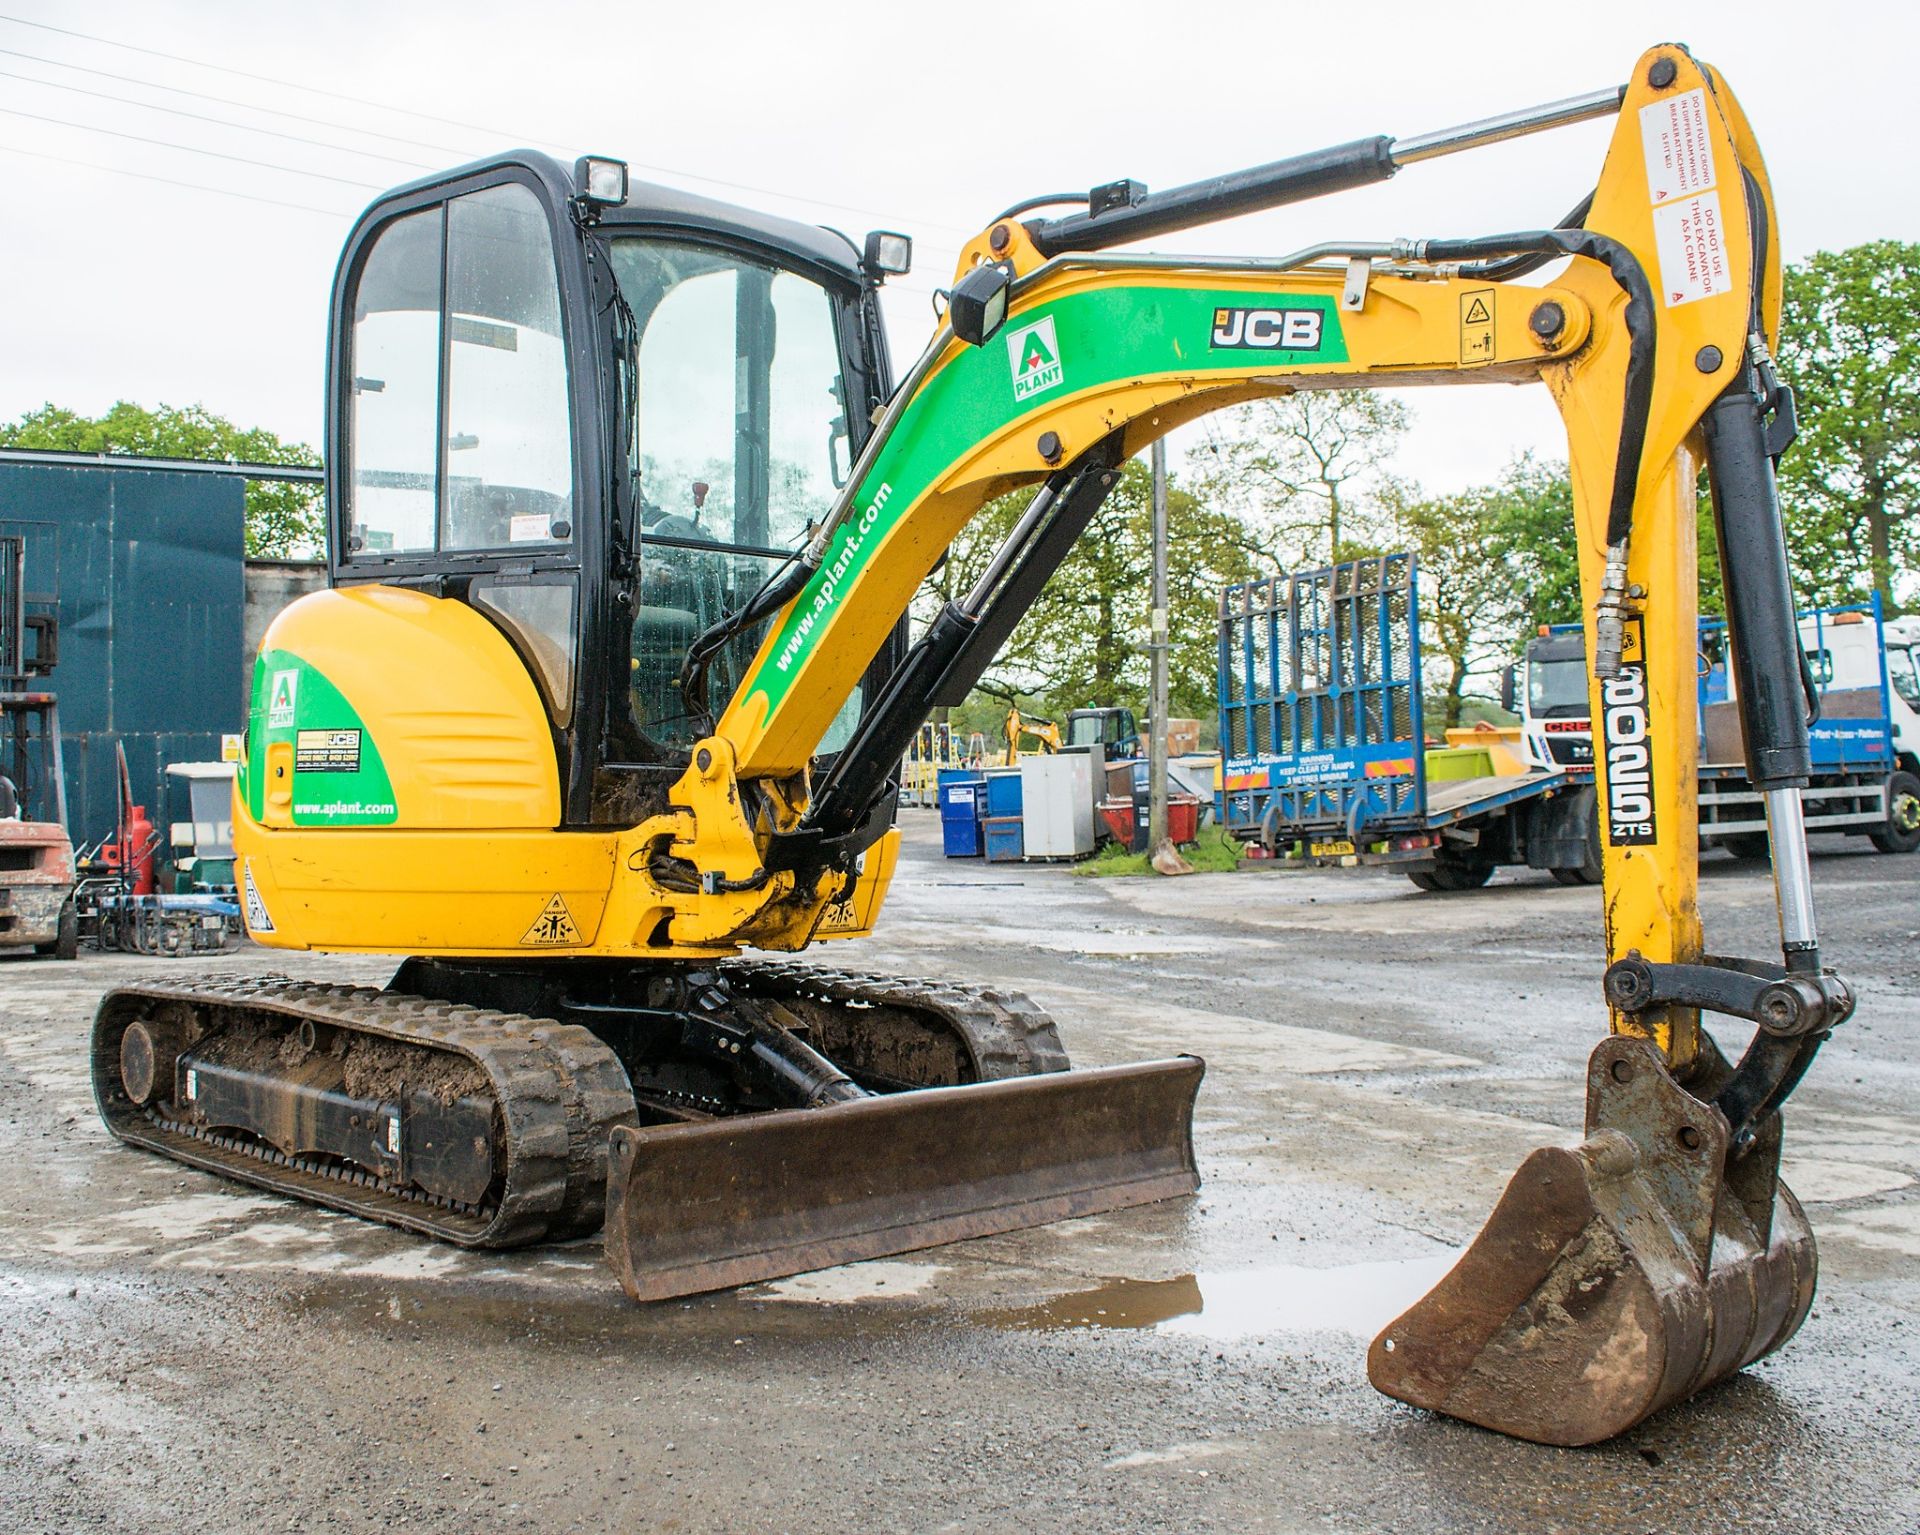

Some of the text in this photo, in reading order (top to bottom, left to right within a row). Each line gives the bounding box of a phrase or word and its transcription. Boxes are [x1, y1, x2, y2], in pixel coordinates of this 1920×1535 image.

[1681, 100, 1688, 109] IN
[1662, 132, 1669, 140] IS
[1682, 110, 1691, 138] DIPPER
[1669, 103, 1688, 191] BREAKER ATTACHMENT
[1692, 96, 1710, 185] DO NOT FULLY CROWD
[1688, 155, 1698, 187] WHILST
[1681, 219, 1698, 283] AS A CRANE
[1691, 200, 1712, 294] THIS EXCAVATOR
[1704, 209, 1722, 277] DO NOT USE
[1213, 310, 1321, 347] JCB
[1018, 330, 1055, 376] A
[1015, 366, 1060, 396] PLANT
[776, 482, 893, 672] www.aplant.com
[273, 676, 292, 707] A
[328, 734, 357, 746] JCB
[1546, 722, 1592, 732] CRE
[1227, 754, 1294, 768] Access Platforms
[1250, 765, 1270, 775] Plant
[1280, 761, 1355, 775] KEEP CLEAR OF RAMPS
[1299, 754, 1334, 764] WARNING
[1292, 774, 1319, 784] METRES
[294, 801, 394, 818] www.aplant.com
[1612, 824, 1653, 837] ZTS
